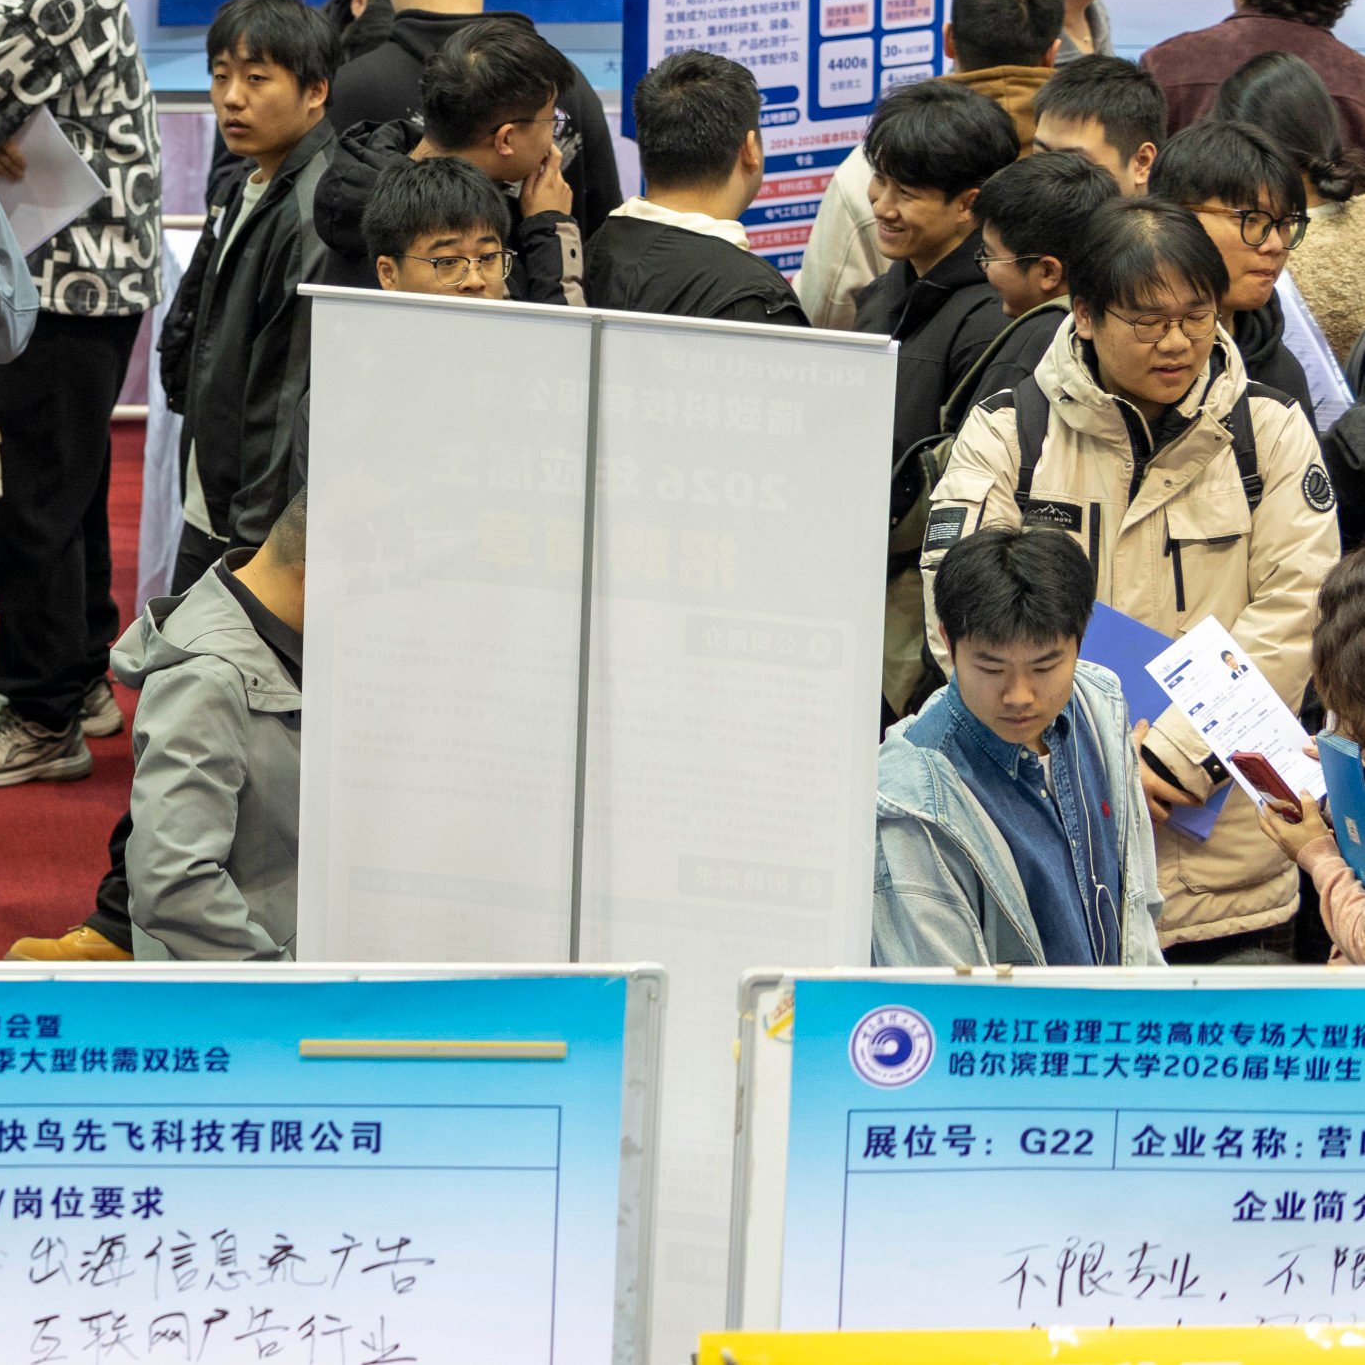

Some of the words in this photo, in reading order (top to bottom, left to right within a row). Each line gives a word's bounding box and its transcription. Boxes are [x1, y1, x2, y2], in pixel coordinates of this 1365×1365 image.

[1019, 1128, 1095, 1157] G22
[27, 1227, 436, 1298] 出海信息流广告
[29, 1306, 419, 1365] 互联网广告行业
